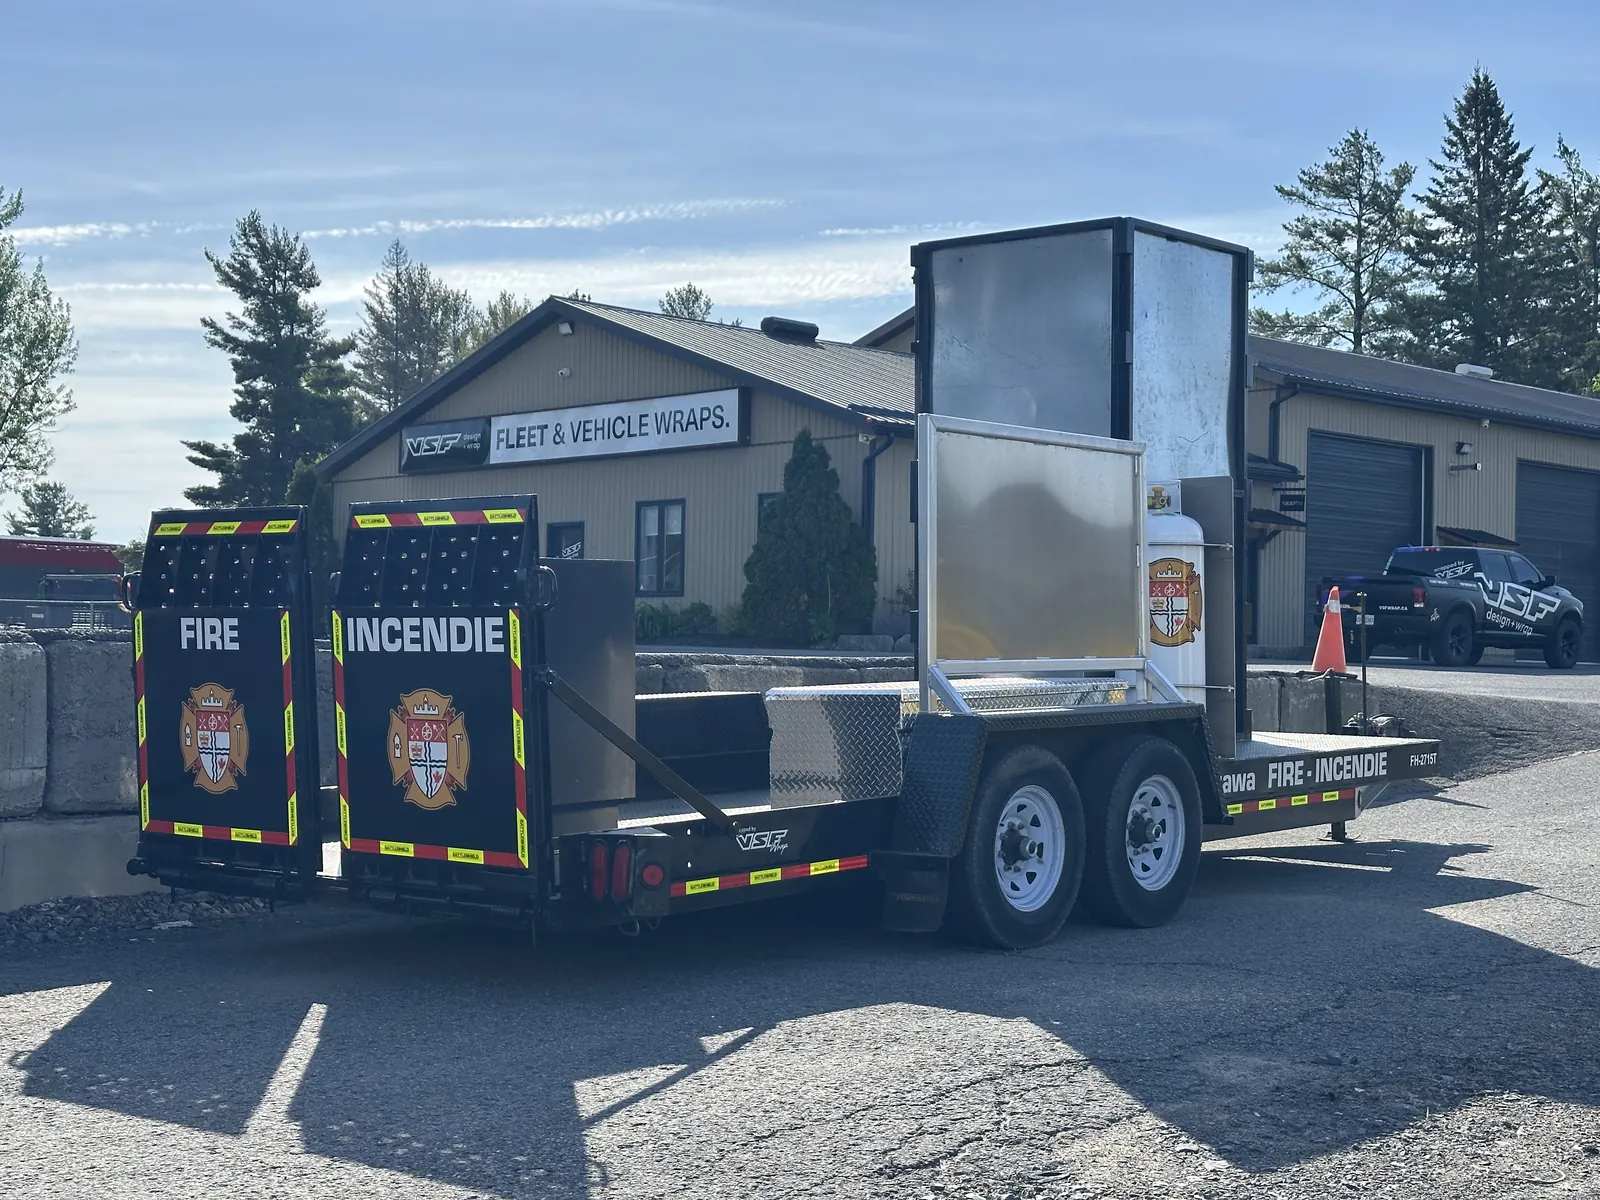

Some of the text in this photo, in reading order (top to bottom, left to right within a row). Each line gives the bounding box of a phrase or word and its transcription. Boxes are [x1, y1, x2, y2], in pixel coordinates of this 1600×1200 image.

[496, 404, 730, 450] FLEET & VEHICLE WRAPS.
[406, 433, 462, 456] VSF
[1473, 572, 1561, 622] VSF
[180, 617, 240, 650] FIRE
[346, 617, 505, 653] INCENDIE
[1220, 772, 1256, 793] awa
[1268, 760, 1304, 788] FIRE
[1315, 752, 1388, 783] INCENDIE
[1410, 752, 1437, 767] FH-2715T
[736, 829, 788, 850] VSF
